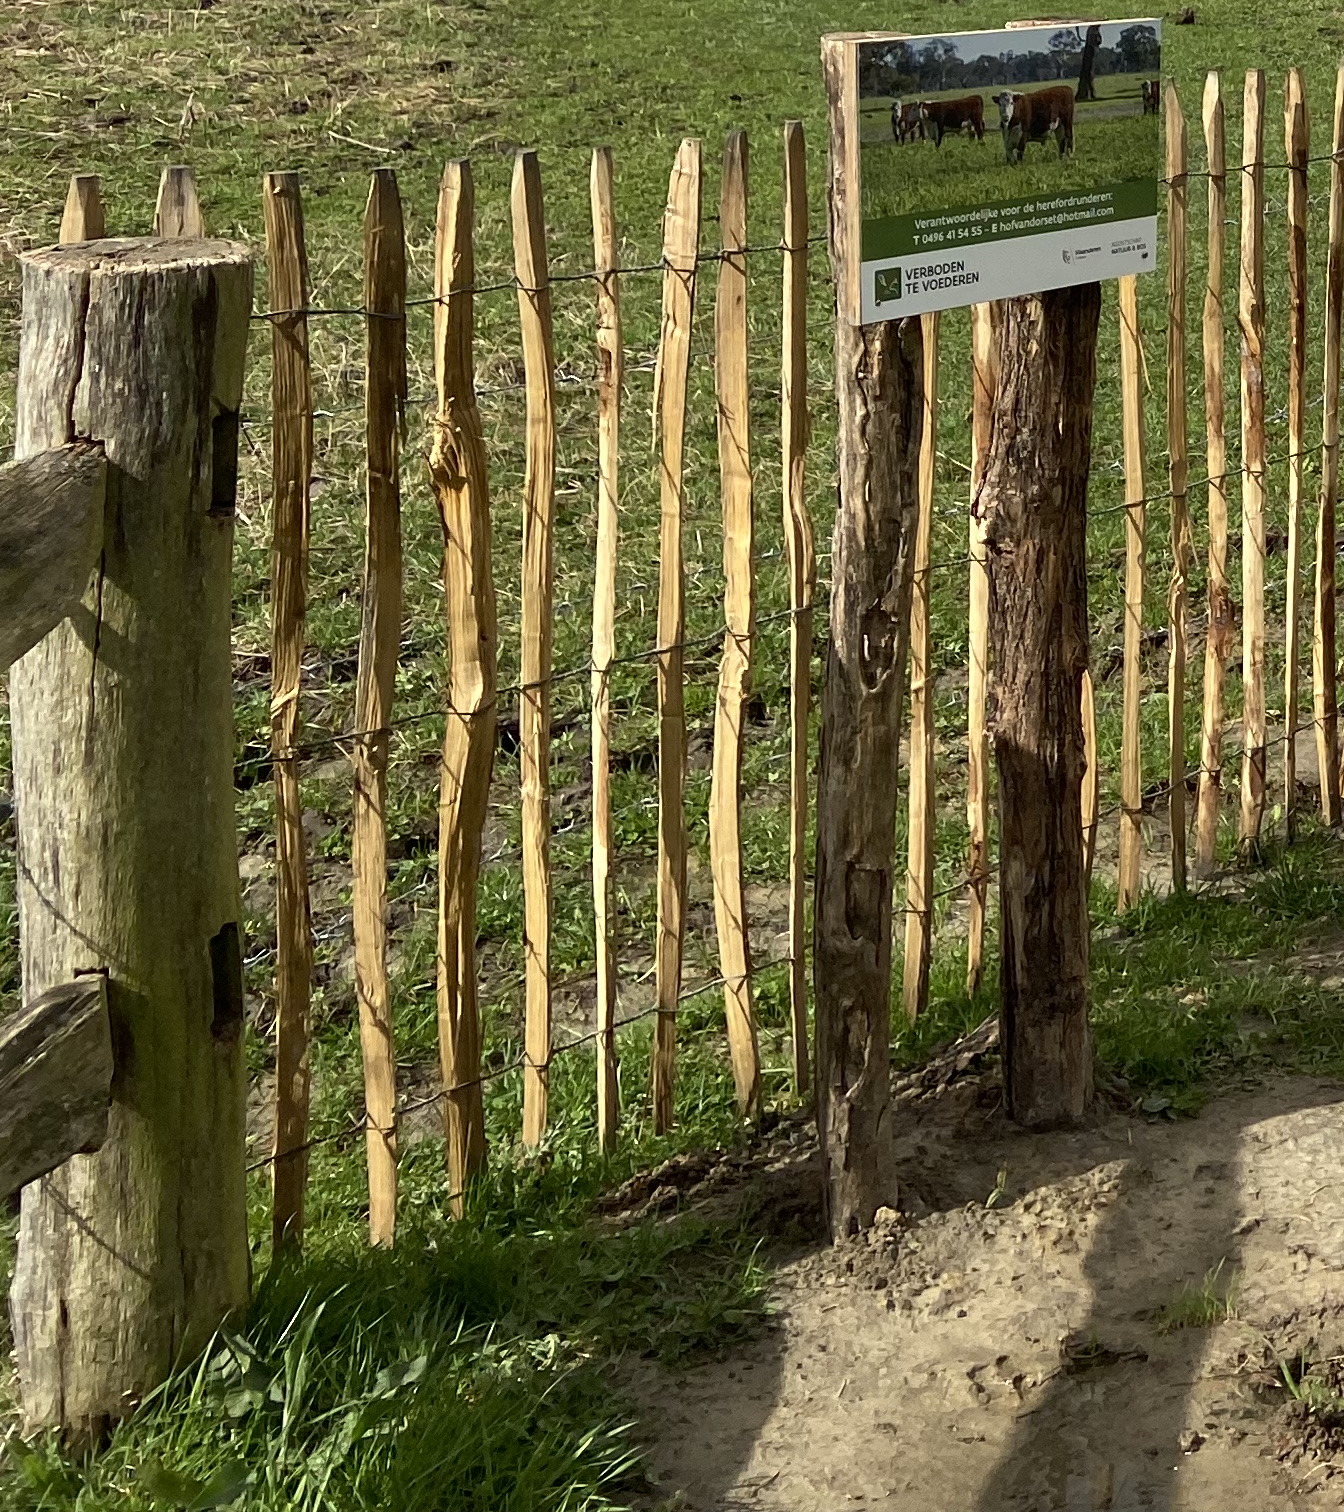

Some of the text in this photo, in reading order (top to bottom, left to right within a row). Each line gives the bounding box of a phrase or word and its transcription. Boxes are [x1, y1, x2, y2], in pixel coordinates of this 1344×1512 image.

[912, 235, 920, 246] T
[922, 231, 944, 245] 0496
[946, 229, 956, 240] 41
[957, 227, 969, 239] 54
[971, 225, 983, 237] 55
[991, 224, 998, 234] E
[999, 206, 1115, 232] hofvandorset@hotmail.com
[914, 192, 1114, 230] Verantwoordelijke voor de herefordrunderen:
[905, 260, 965, 281] VERBODEN
[905, 271, 980, 295] TE VOEDEREN
